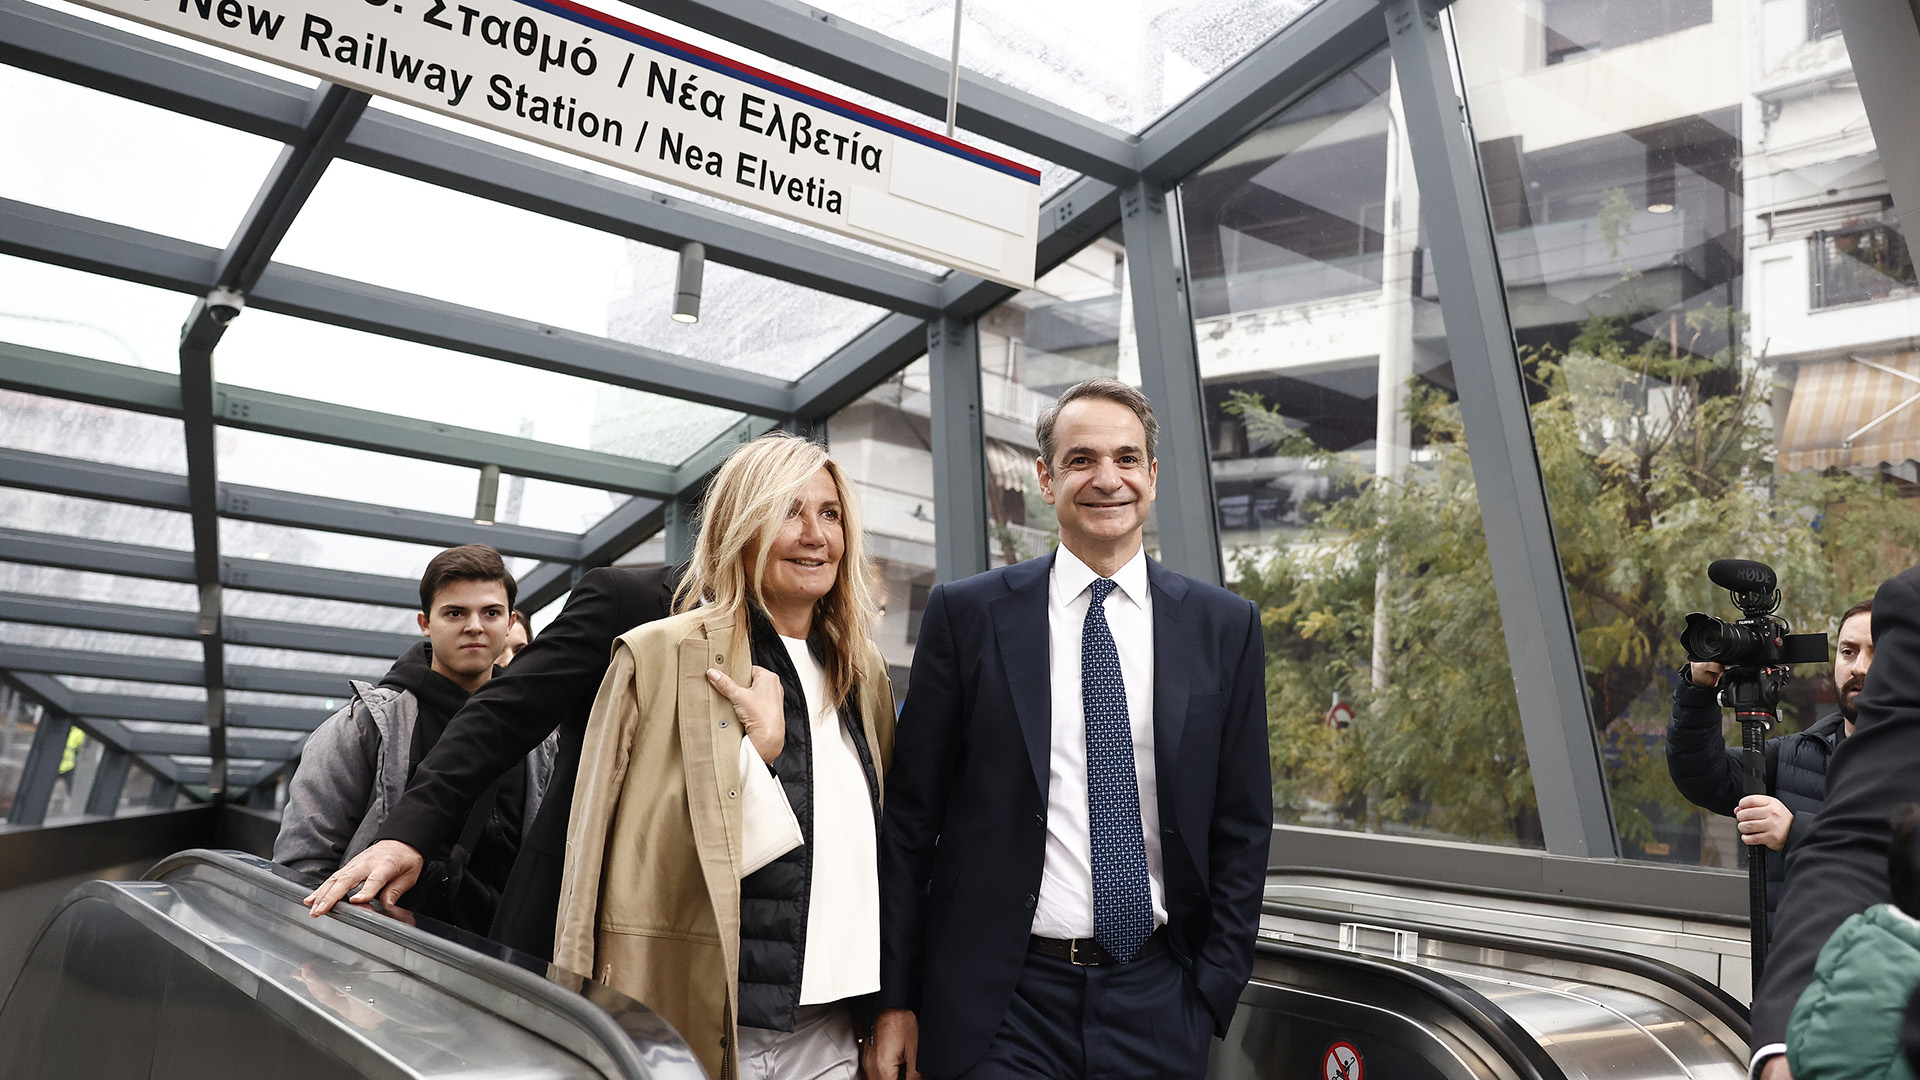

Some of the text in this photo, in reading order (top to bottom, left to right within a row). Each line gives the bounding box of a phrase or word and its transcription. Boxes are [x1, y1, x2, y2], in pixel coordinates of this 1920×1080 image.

[301, 12, 474, 107] Railway
[486, 73, 623, 147] Station
[634, 120, 649, 153] /
[658, 127, 723, 178] Nea
[735, 151, 843, 215] Elvetia
[424, 0, 883, 173] Σταθμό / Νέα Ελβετία
